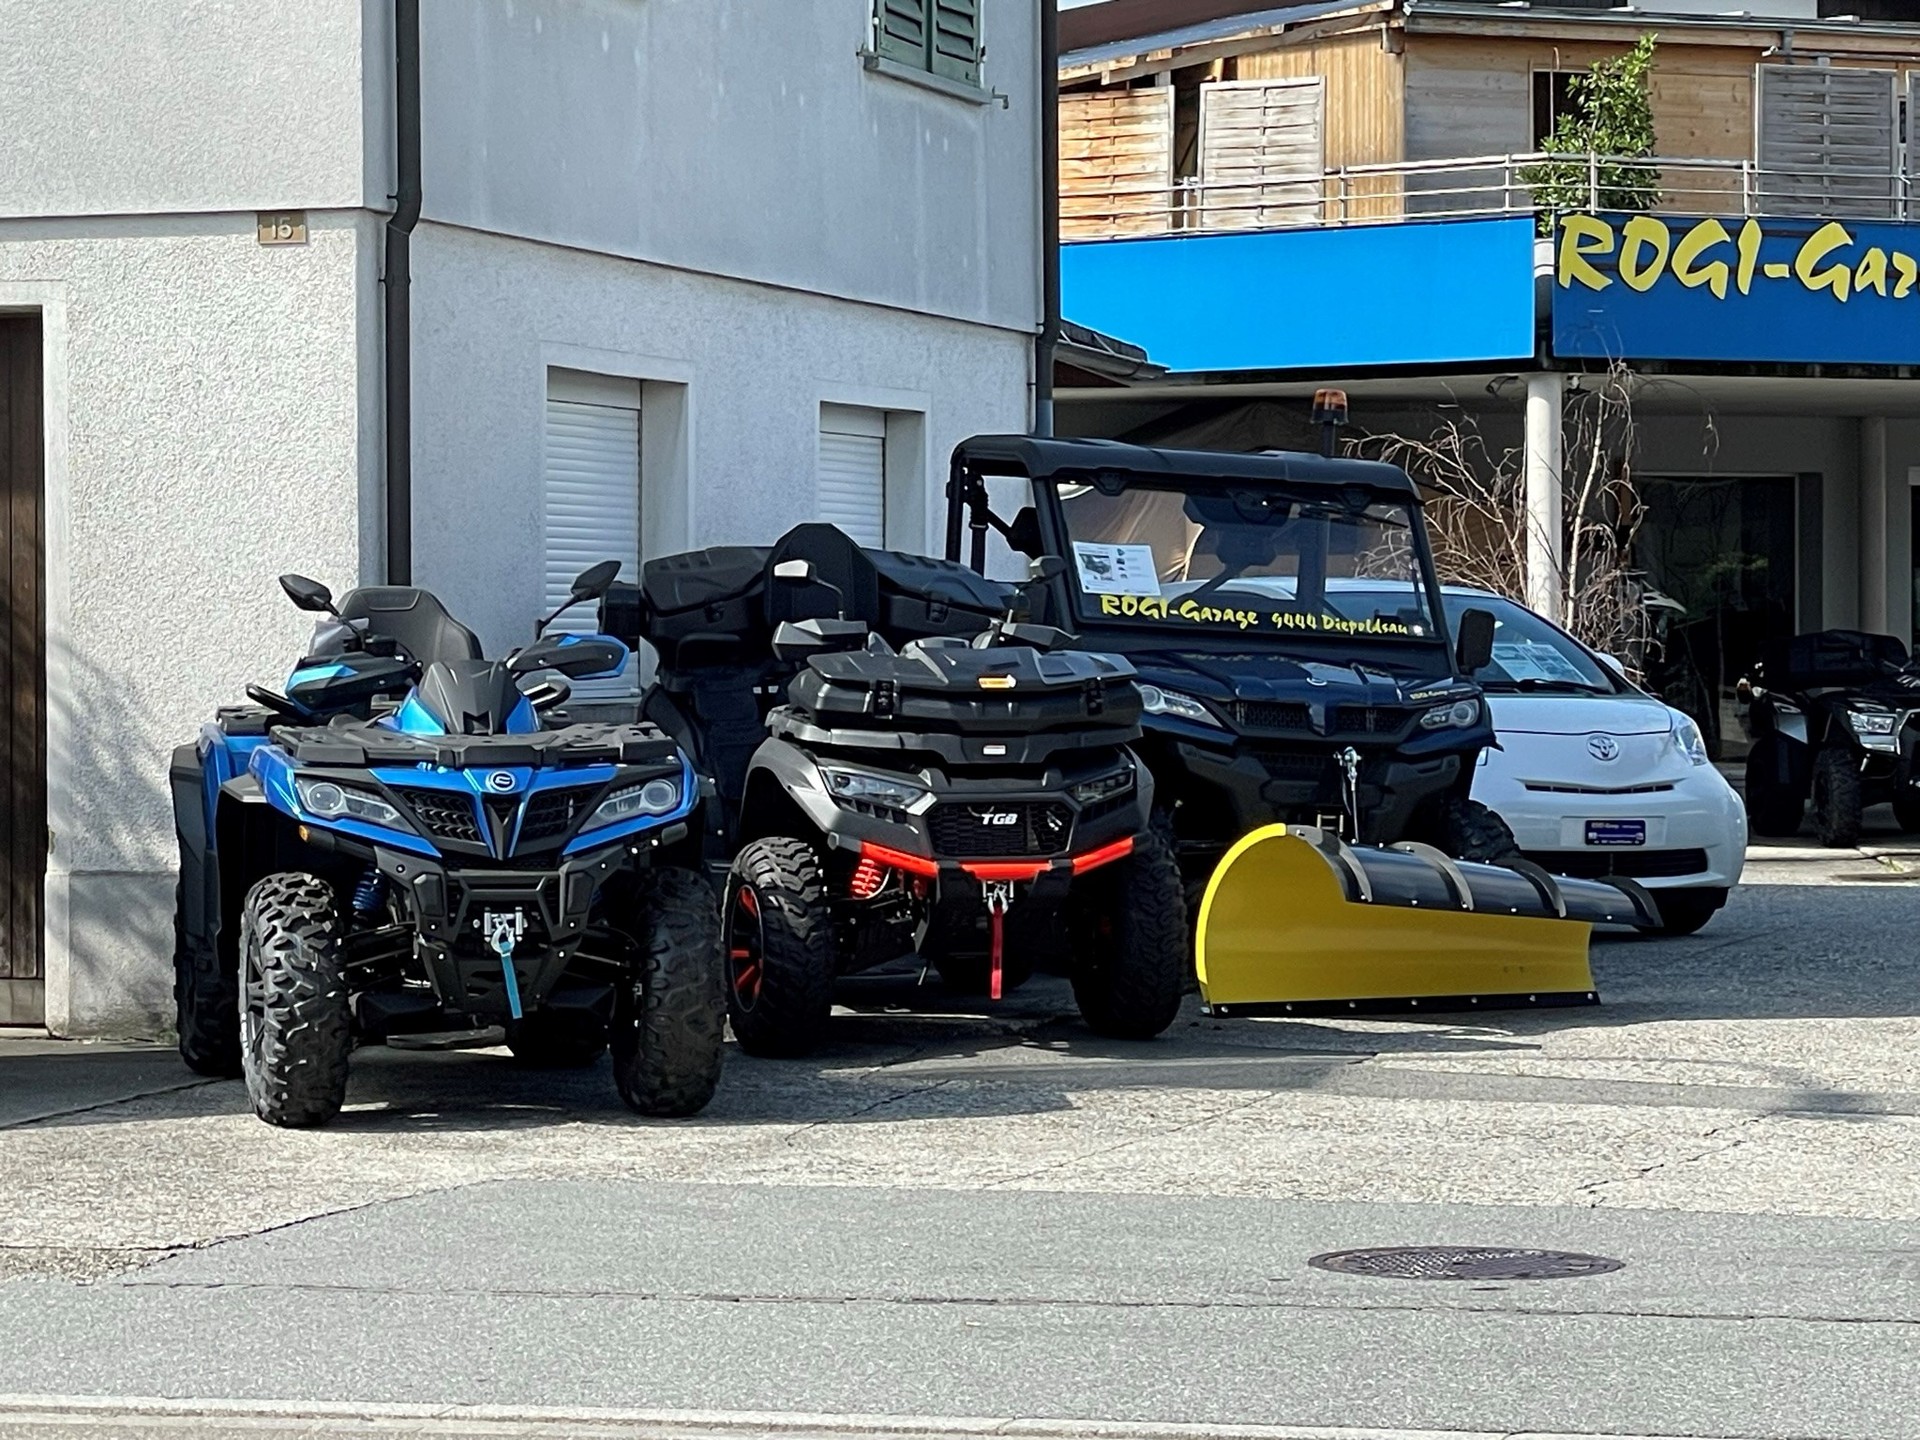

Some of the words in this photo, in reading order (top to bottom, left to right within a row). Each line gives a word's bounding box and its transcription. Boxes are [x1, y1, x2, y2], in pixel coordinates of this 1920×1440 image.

[270, 217, 293, 239] 15
[1558, 214, 1920, 302] ROGI-Gar
[1100, 594, 1259, 630] ROGI-Garage
[1271, 612, 1318, 630] 9444
[982, 813, 1018, 825] TGB
